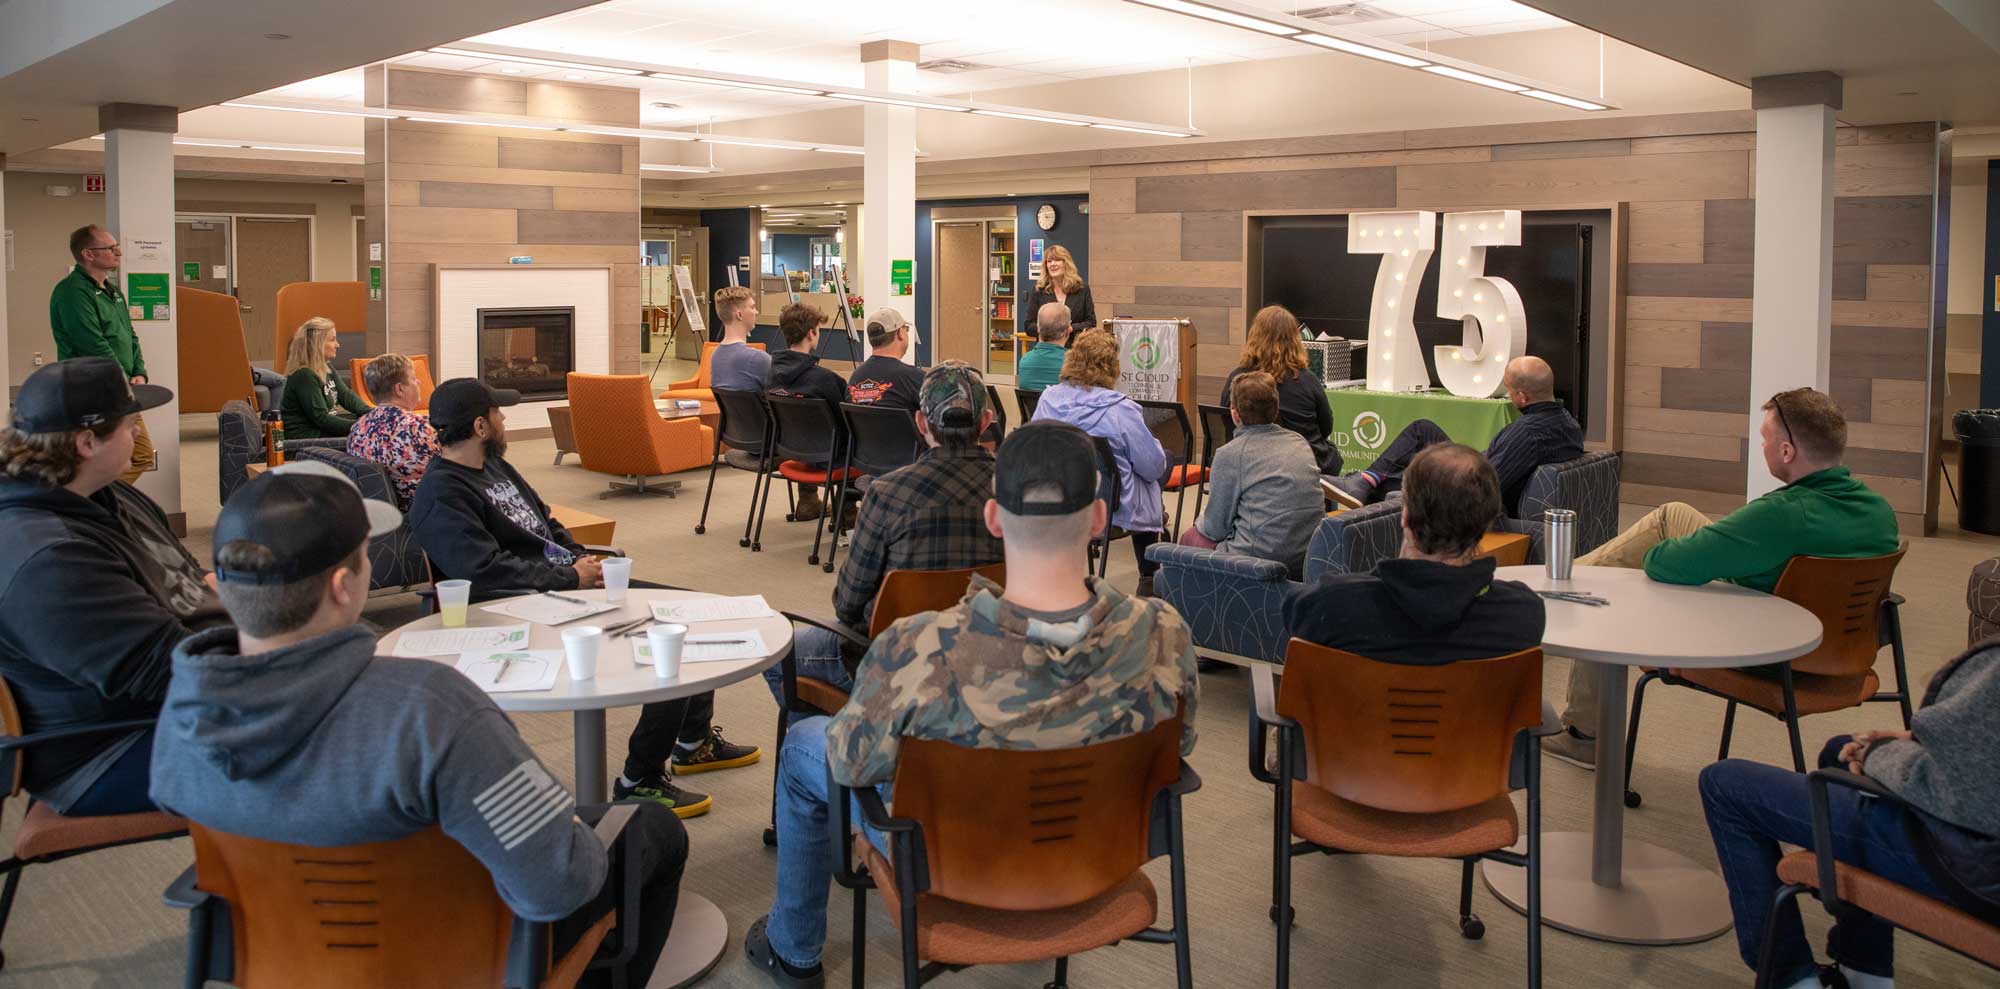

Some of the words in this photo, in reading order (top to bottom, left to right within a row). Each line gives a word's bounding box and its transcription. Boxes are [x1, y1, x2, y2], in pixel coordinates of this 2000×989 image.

[1348, 210, 1527, 398] 75
[1121, 371, 1133, 382] ST
[1135, 371, 1169, 383] CLOUD
